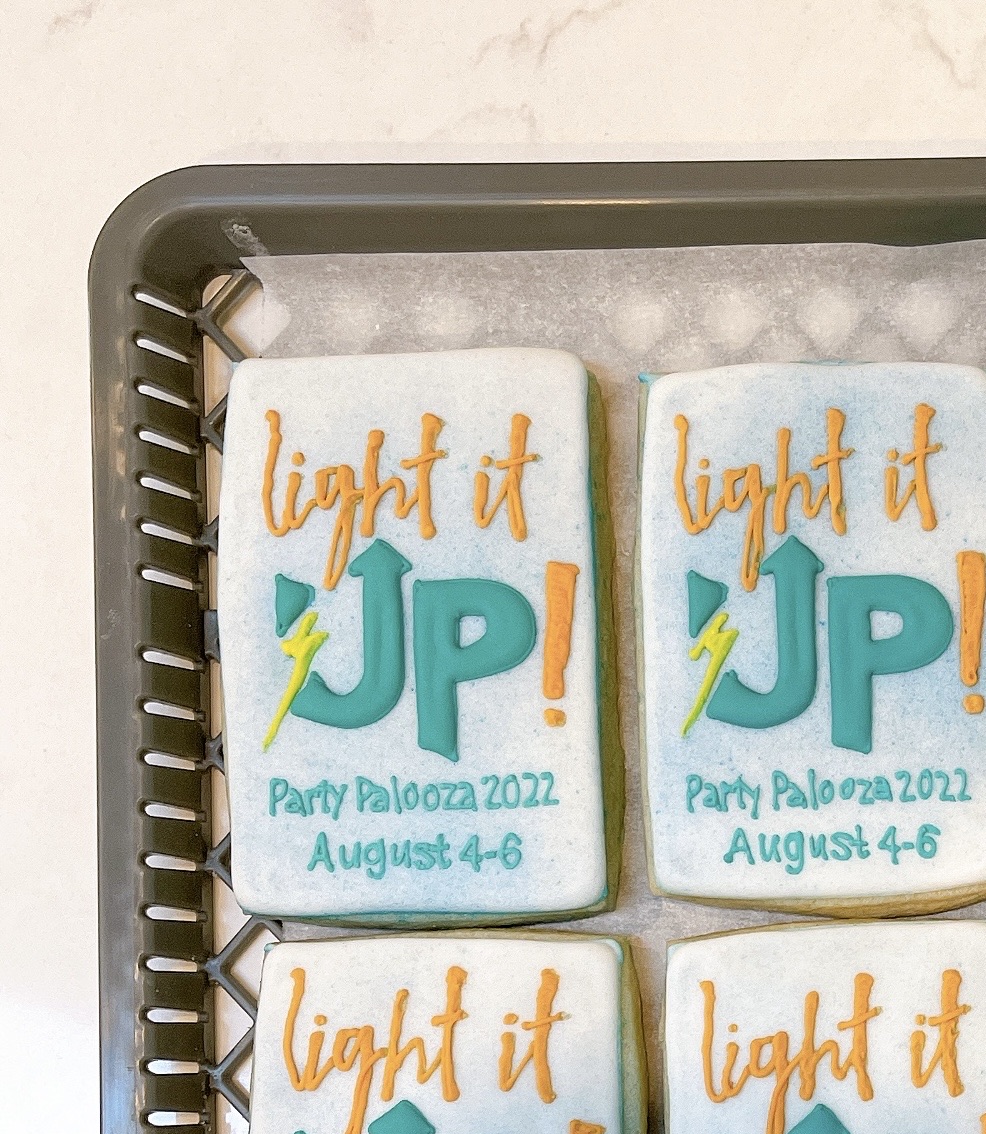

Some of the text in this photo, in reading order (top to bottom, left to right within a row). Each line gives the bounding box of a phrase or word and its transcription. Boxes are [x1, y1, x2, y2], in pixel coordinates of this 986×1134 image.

[475, 414, 539, 540] it
[886, 404, 942, 530] it
[269, 772, 559, 821] Party Palooza 2022
[686, 768, 972, 820] Party Palooza 2022
[307, 831, 522, 880] August 4-6
[723, 823, 941, 875] August 4-6
[500, 969, 566, 1102] it
[911, 970, 972, 1096] it
